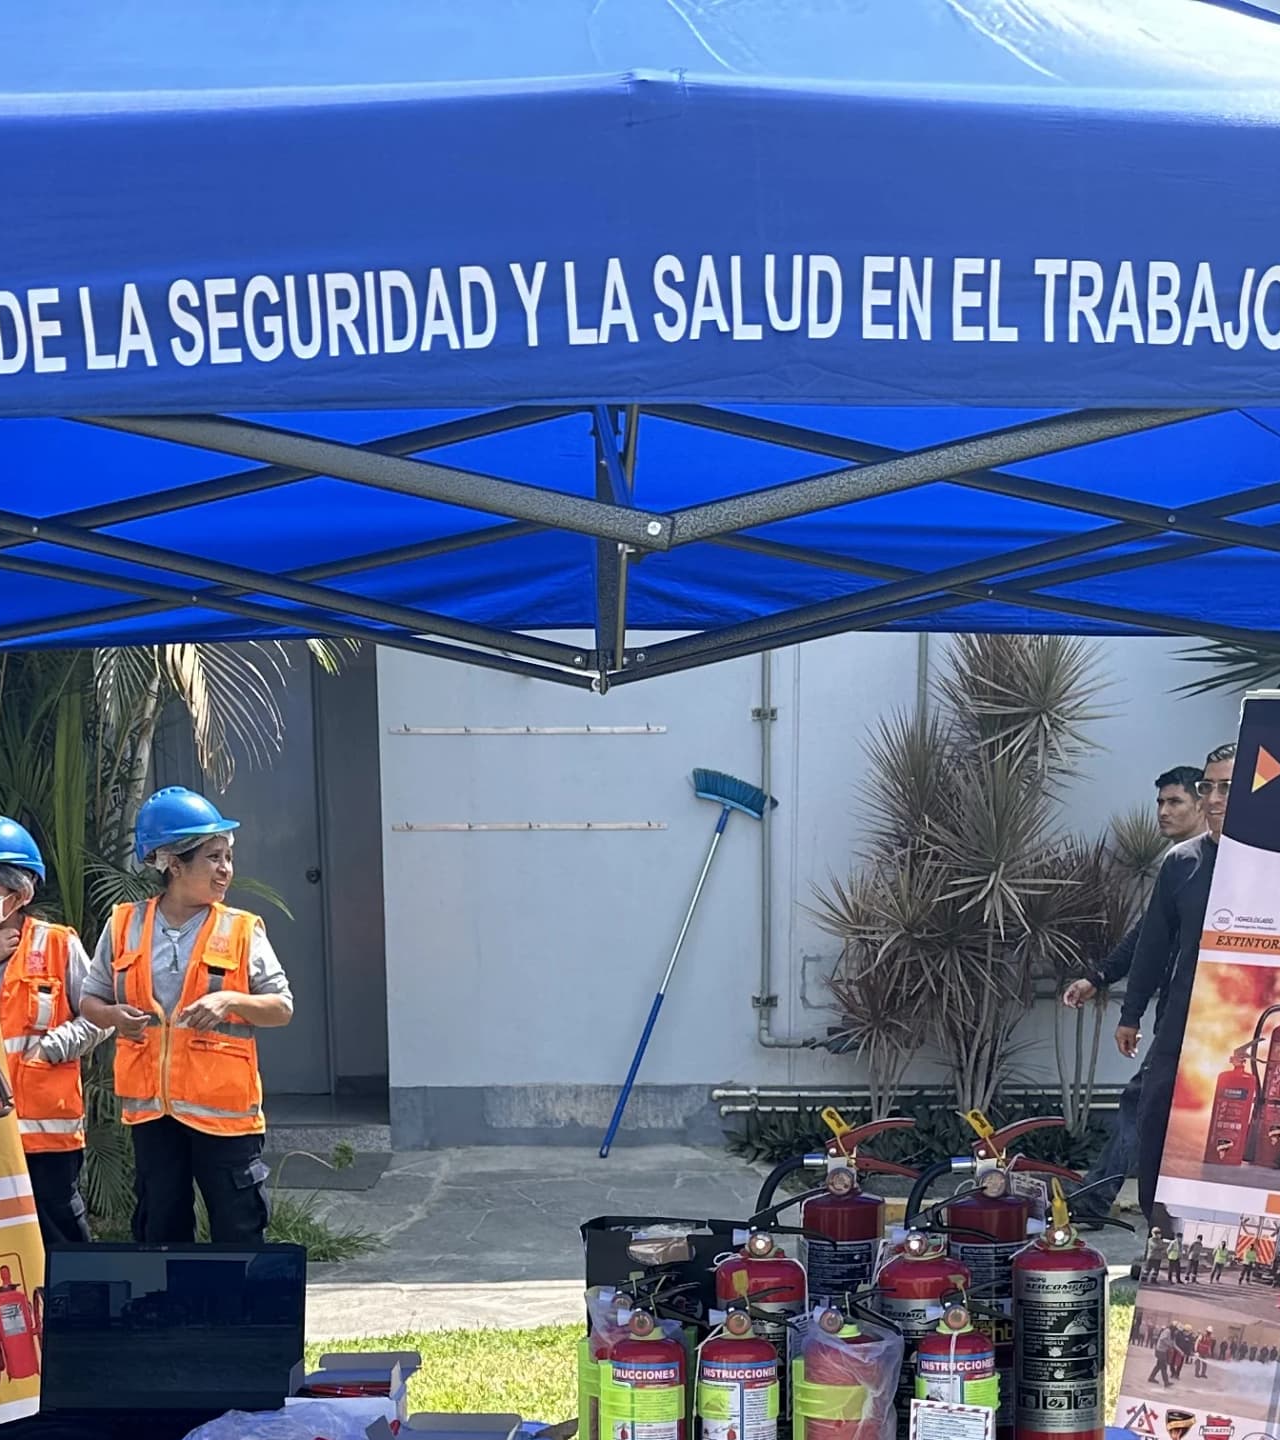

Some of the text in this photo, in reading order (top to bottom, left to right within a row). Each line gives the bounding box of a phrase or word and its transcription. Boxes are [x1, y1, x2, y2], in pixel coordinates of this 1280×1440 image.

[77, 282, 158, 371] LA
[168, 265, 497, 366] SEGURIDAD
[509, 261, 548, 348] Y
[564, 257, 639, 346] LA
[651, 253, 843, 344] SALUD
[860, 255, 933, 342] EN
[951, 257, 1019, 343] EL
